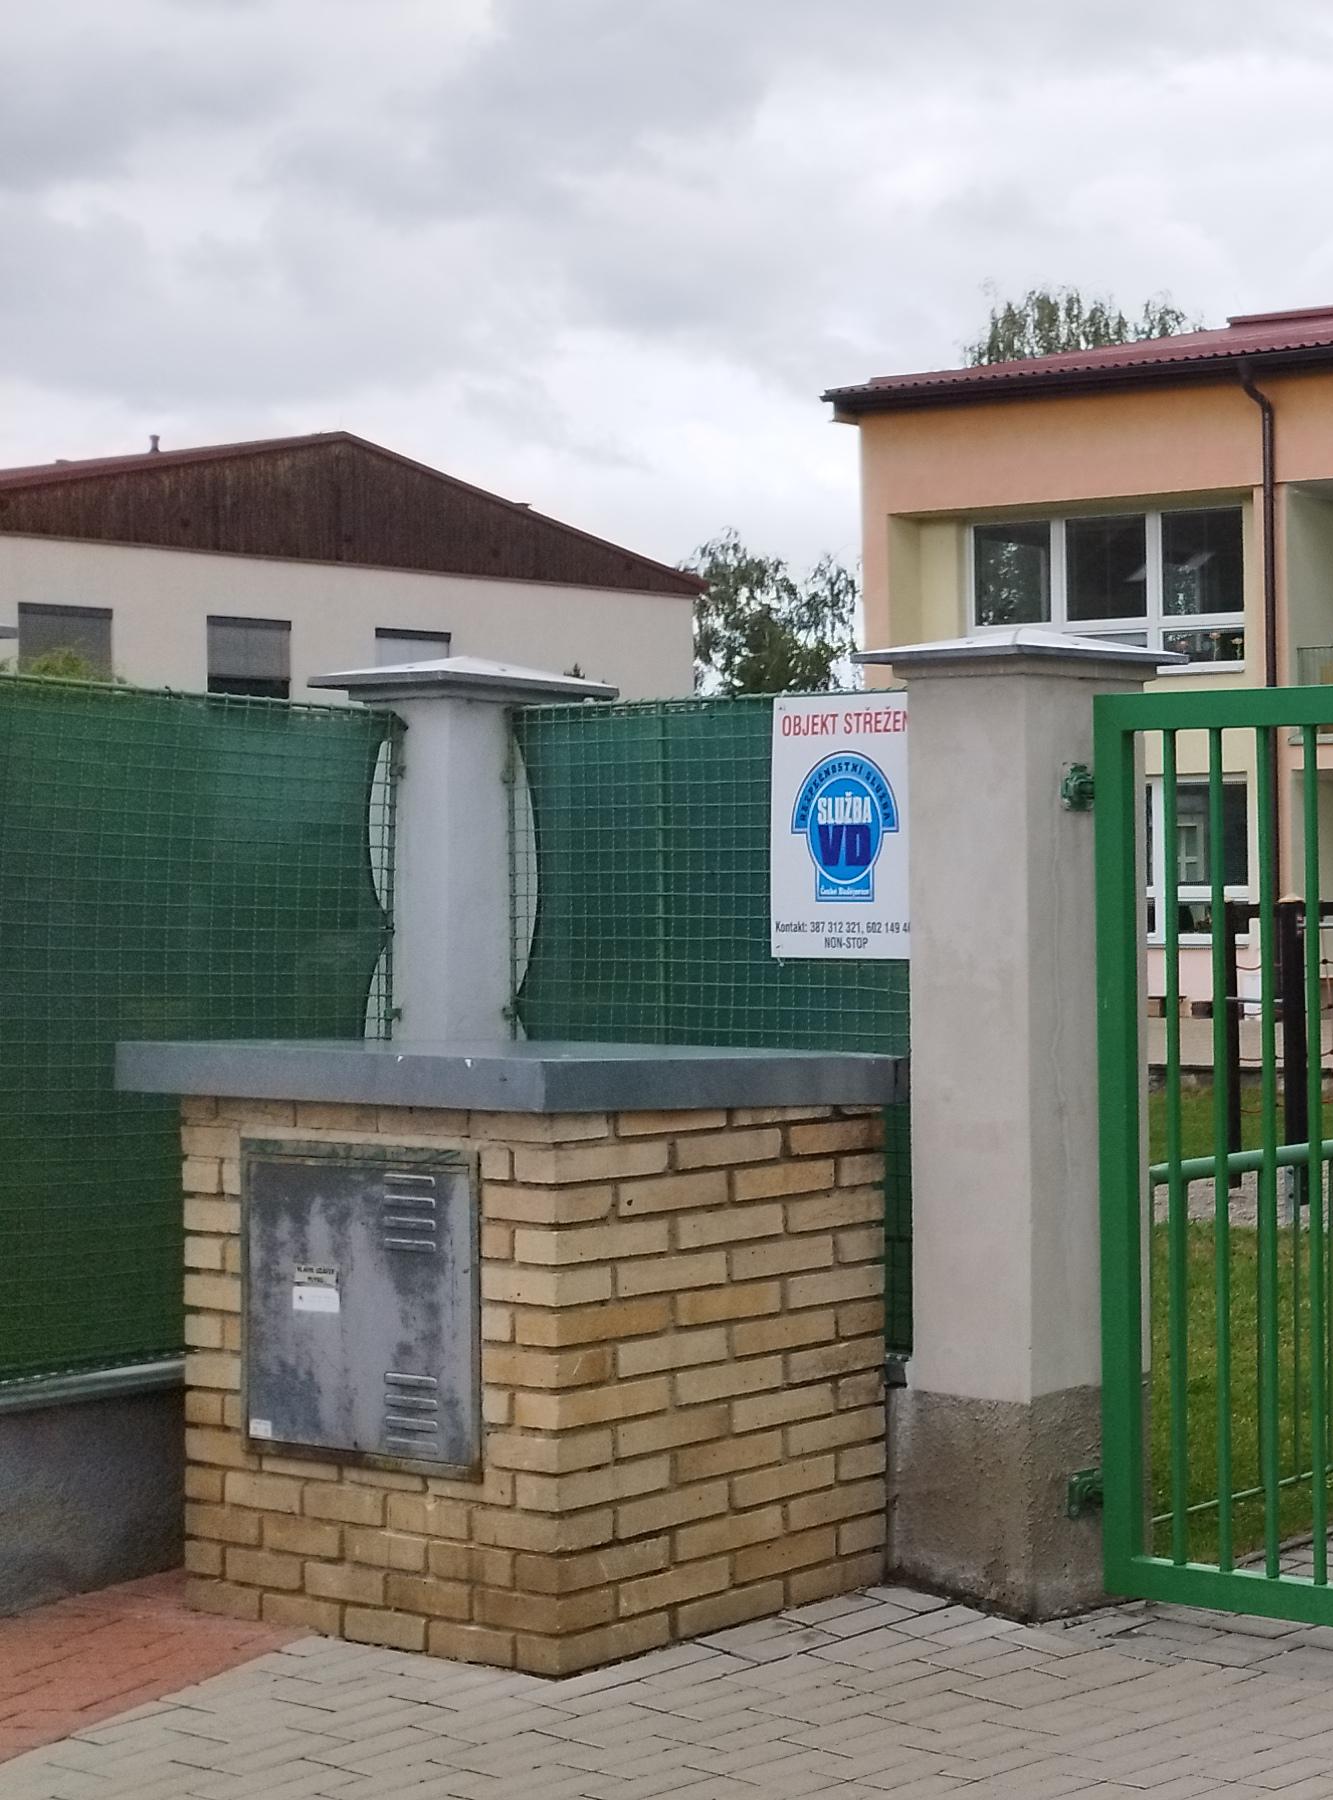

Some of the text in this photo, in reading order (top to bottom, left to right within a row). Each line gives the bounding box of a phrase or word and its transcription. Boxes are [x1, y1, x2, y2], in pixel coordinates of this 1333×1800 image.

[782, 713, 838, 736] OBJEKT
[817, 792, 873, 825] SLUŽBA
[818, 825, 872, 866] VD
[775, 921, 807, 933] Kontakt:
[810, 921, 825, 933] 387
[827, 921, 843, 933] 312
[866, 922, 882, 934] 602
[885, 922, 900, 934] 149
[824, 937, 868, 949] NON-STOP
